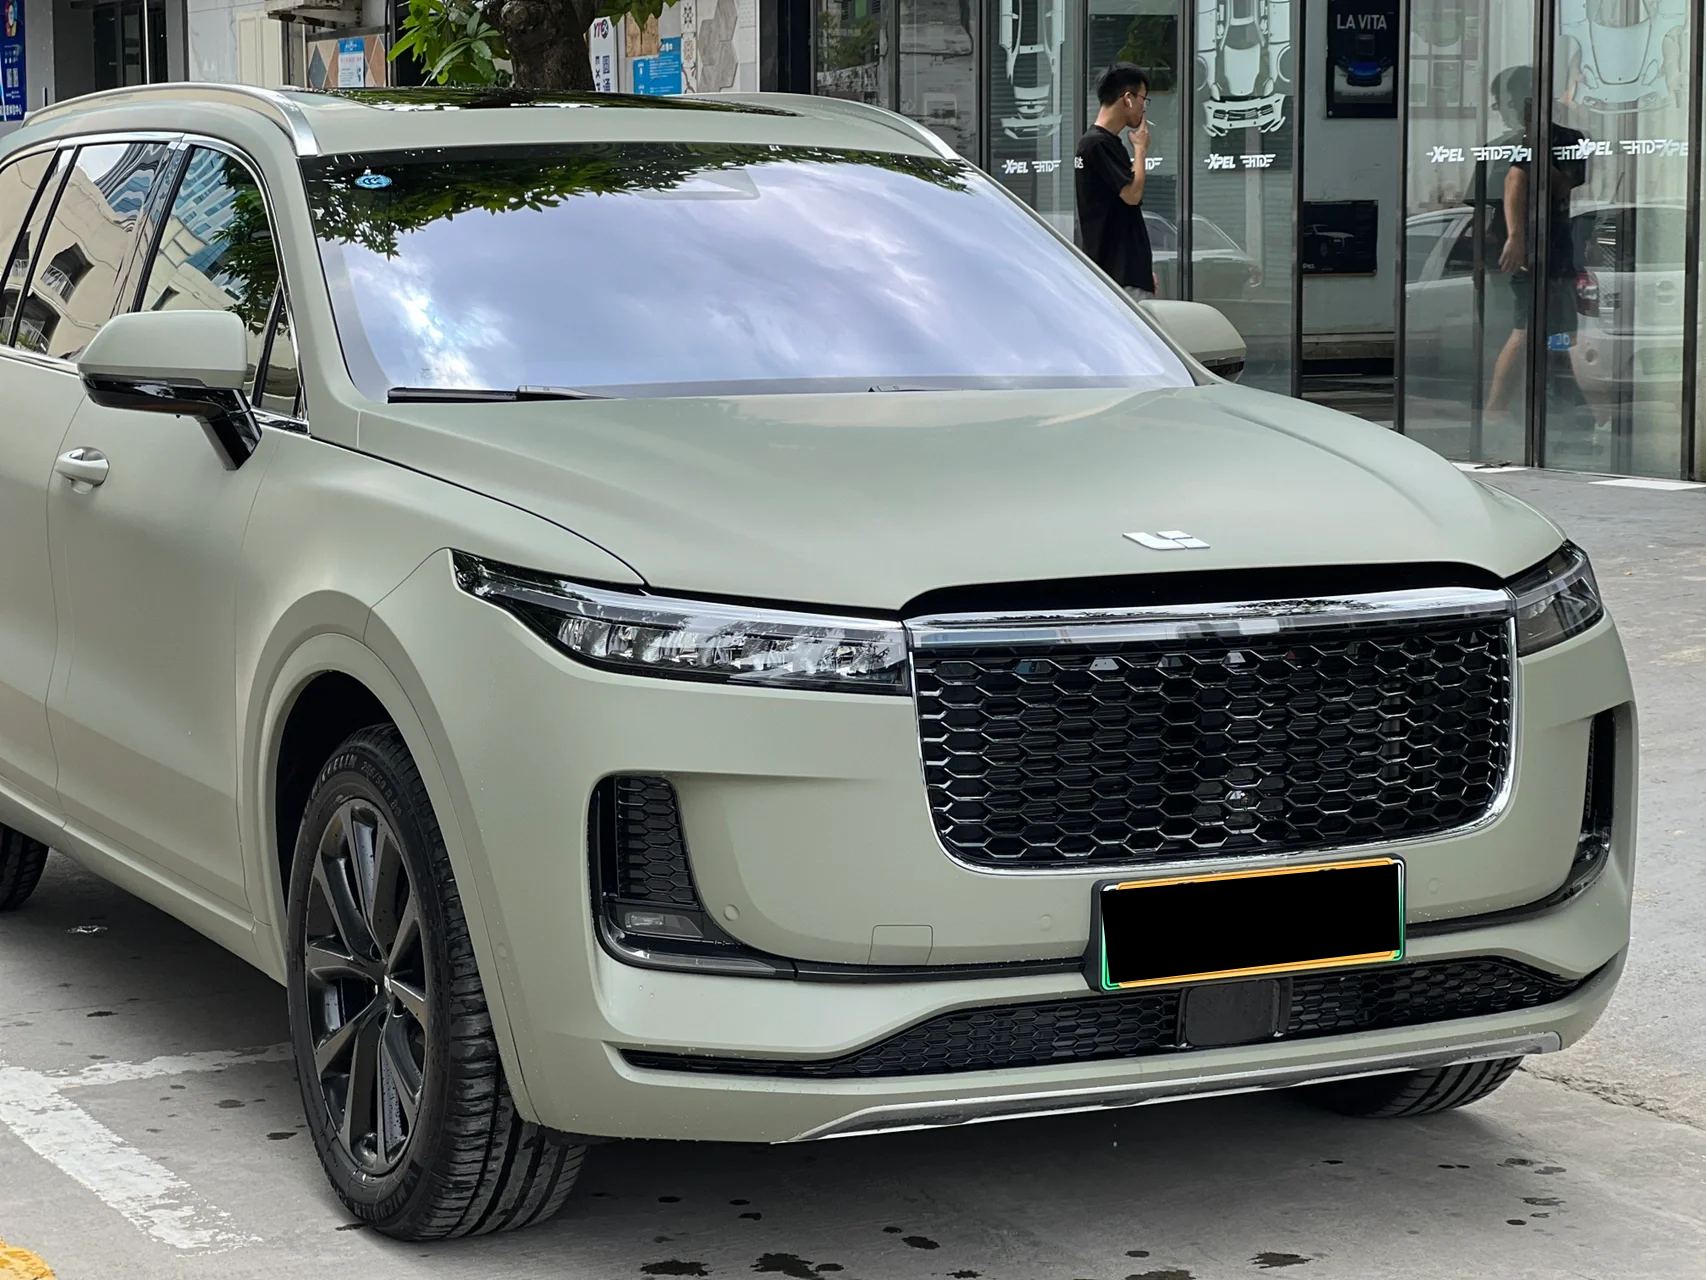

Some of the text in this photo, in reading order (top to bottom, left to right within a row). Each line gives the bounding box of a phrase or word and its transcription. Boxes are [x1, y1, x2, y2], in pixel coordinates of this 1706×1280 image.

[1336, 13, 1388, 30] LA VITA
[1425, 145, 1465, 163] XPEL
[1577, 138, 1613, 156] XPEL
[1001, 159, 1029, 174] XPEL
[1203, 153, 1236, 170] XPEL
